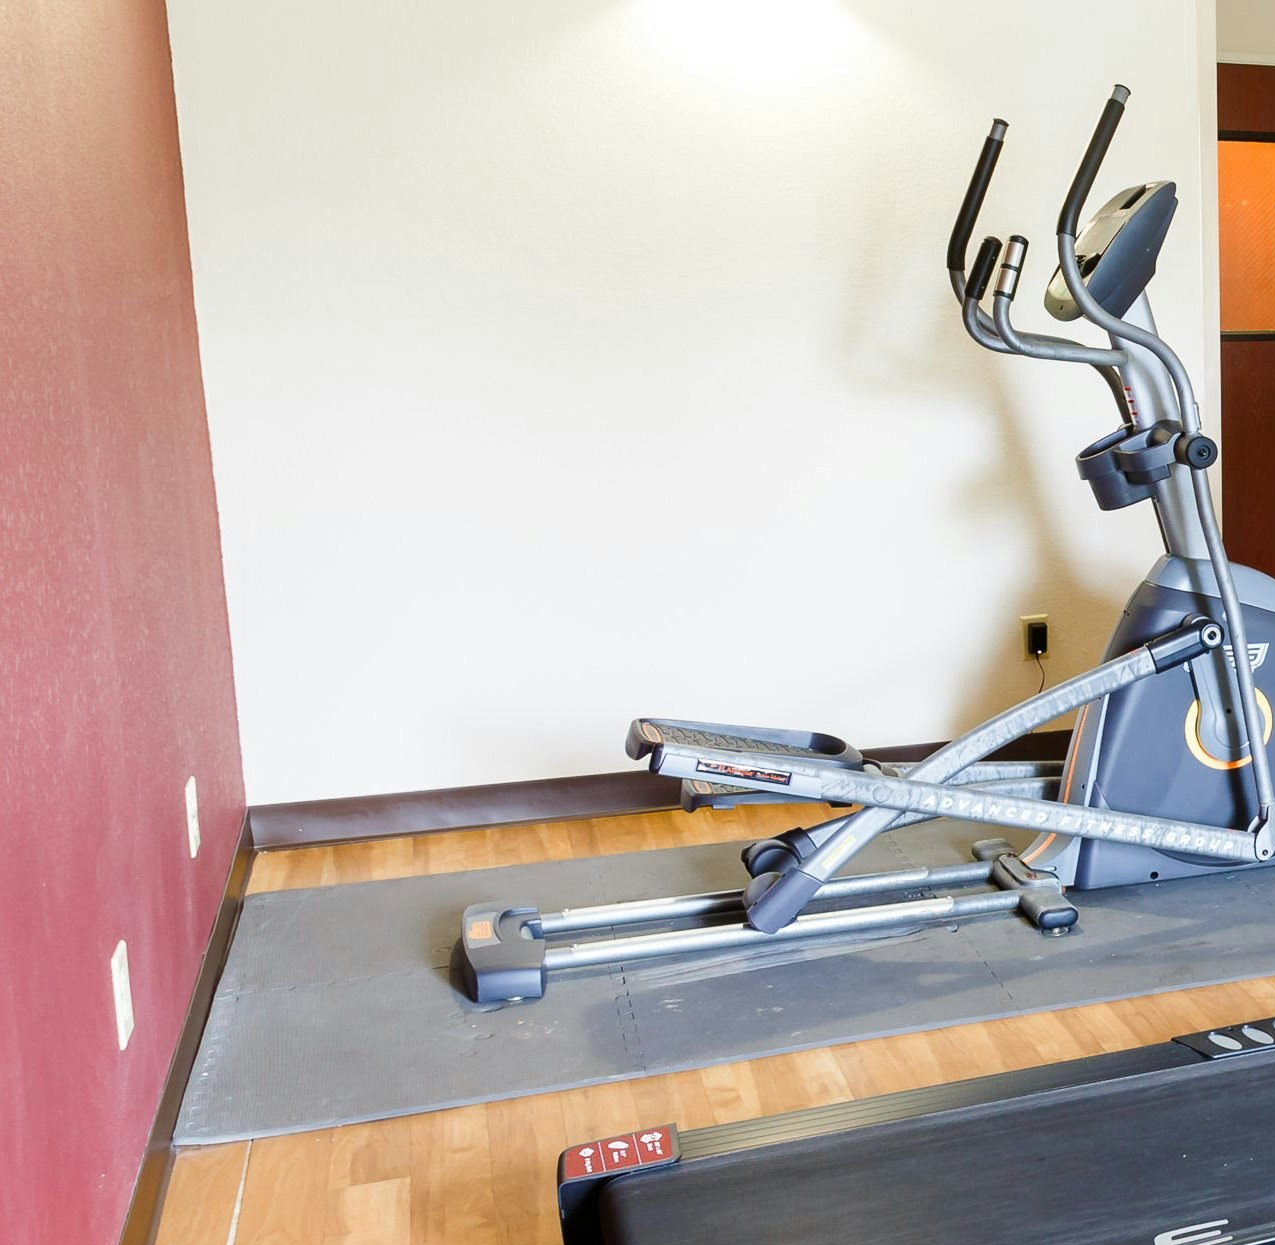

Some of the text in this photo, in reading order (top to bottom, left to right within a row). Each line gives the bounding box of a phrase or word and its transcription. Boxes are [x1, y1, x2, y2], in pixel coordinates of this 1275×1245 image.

[923, 794, 1235, 851] ADVANCED FITNESS GROUP
